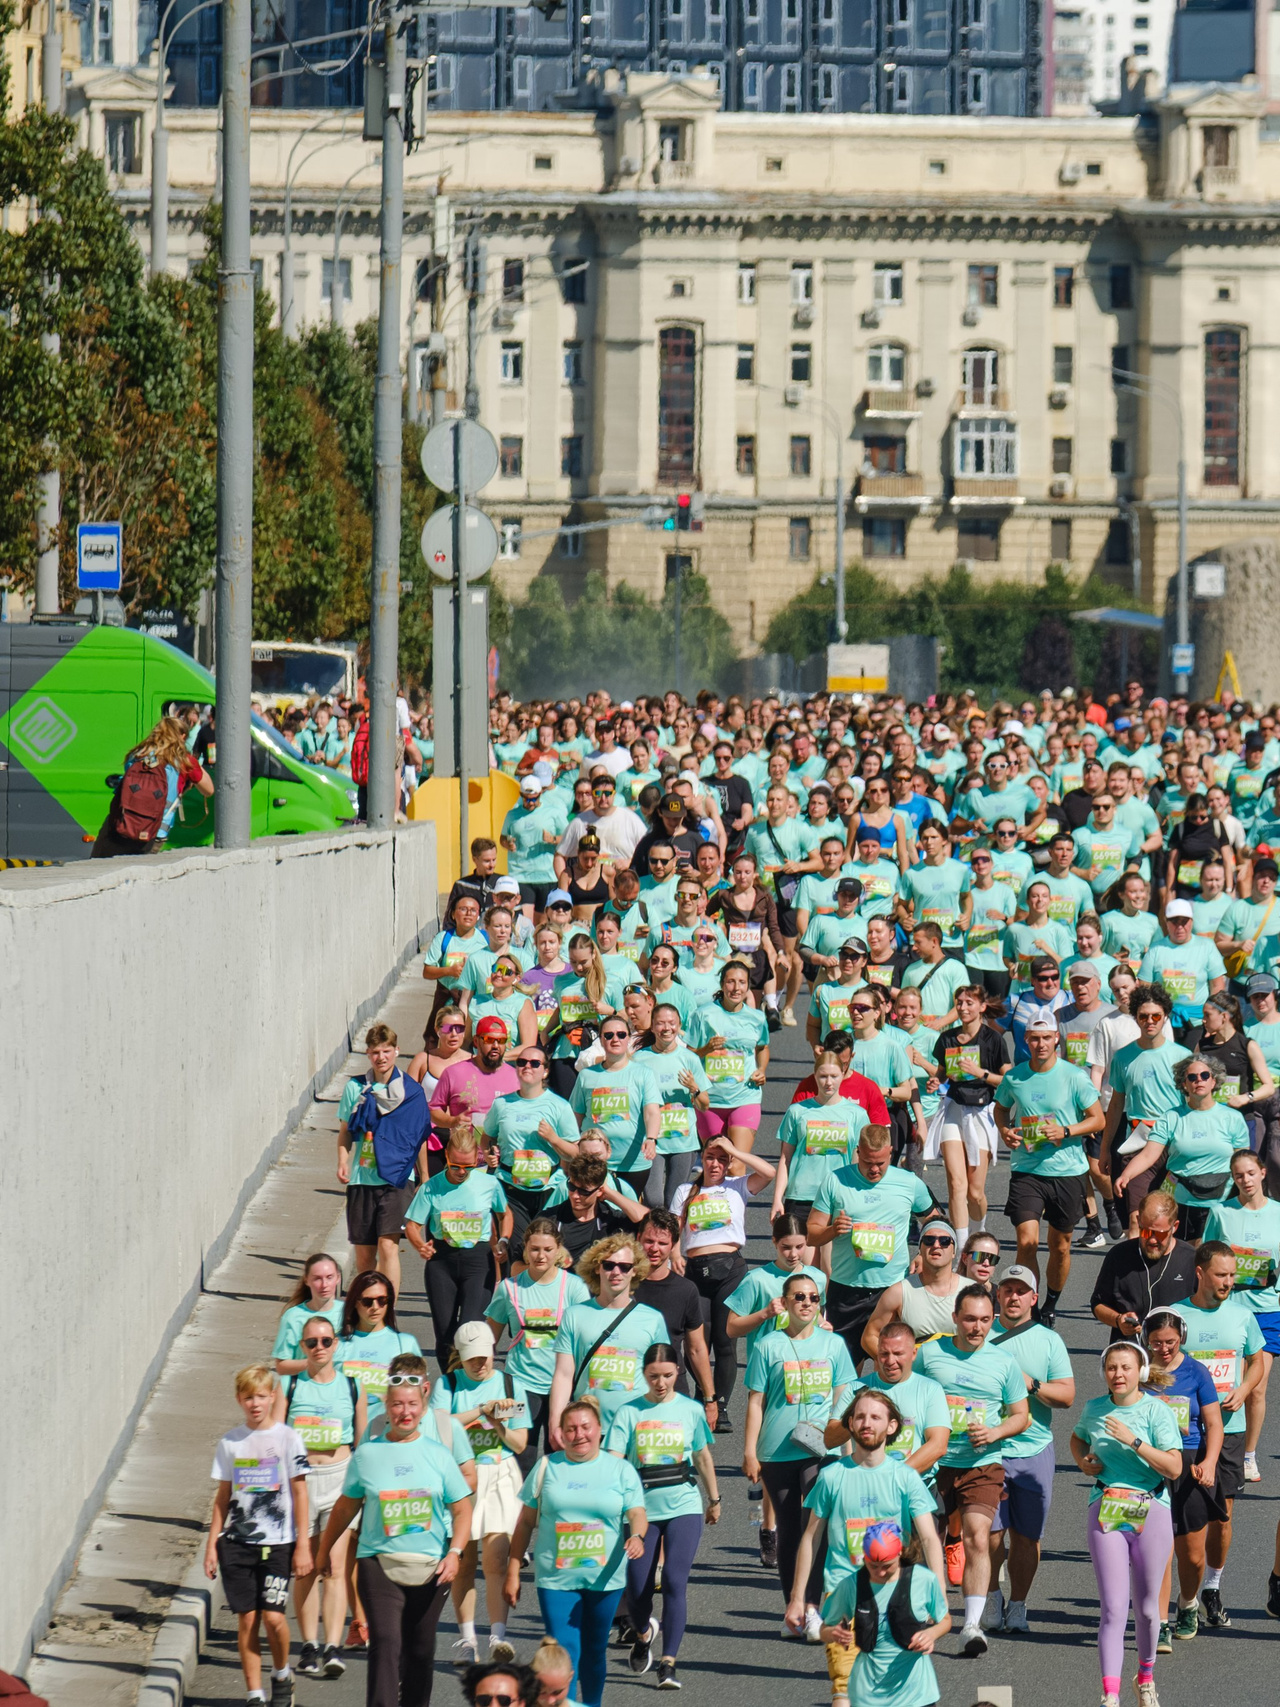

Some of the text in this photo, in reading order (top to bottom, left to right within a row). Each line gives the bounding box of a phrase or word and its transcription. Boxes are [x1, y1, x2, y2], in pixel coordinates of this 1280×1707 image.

[731, 931, 760, 943] 53214
[1163, 978, 1196, 991] 73725
[708, 1059, 744, 1071] 70517
[593, 1096, 628, 1110] 71471
[809, 1128, 847, 1142] 79204
[514, 1159, 551, 1173] 77535
[689, 1201, 728, 1218] 81532
[442, 1220, 482, 1234] 80045
[855, 1230, 893, 1248] 71791
[592, 1356, 635, 1374] 72519
[787, 1371, 831, 1387] 75355
[637, 1432, 683, 1447] 81209
[239, 1476, 272, 1484] АТЛЕТ
[383, 1500, 432, 1519] 69184
[1102, 1500, 1148, 1518] 77758
[558, 1533, 604, 1550] 66760
[264, 1575, 289, 1590] DAY
